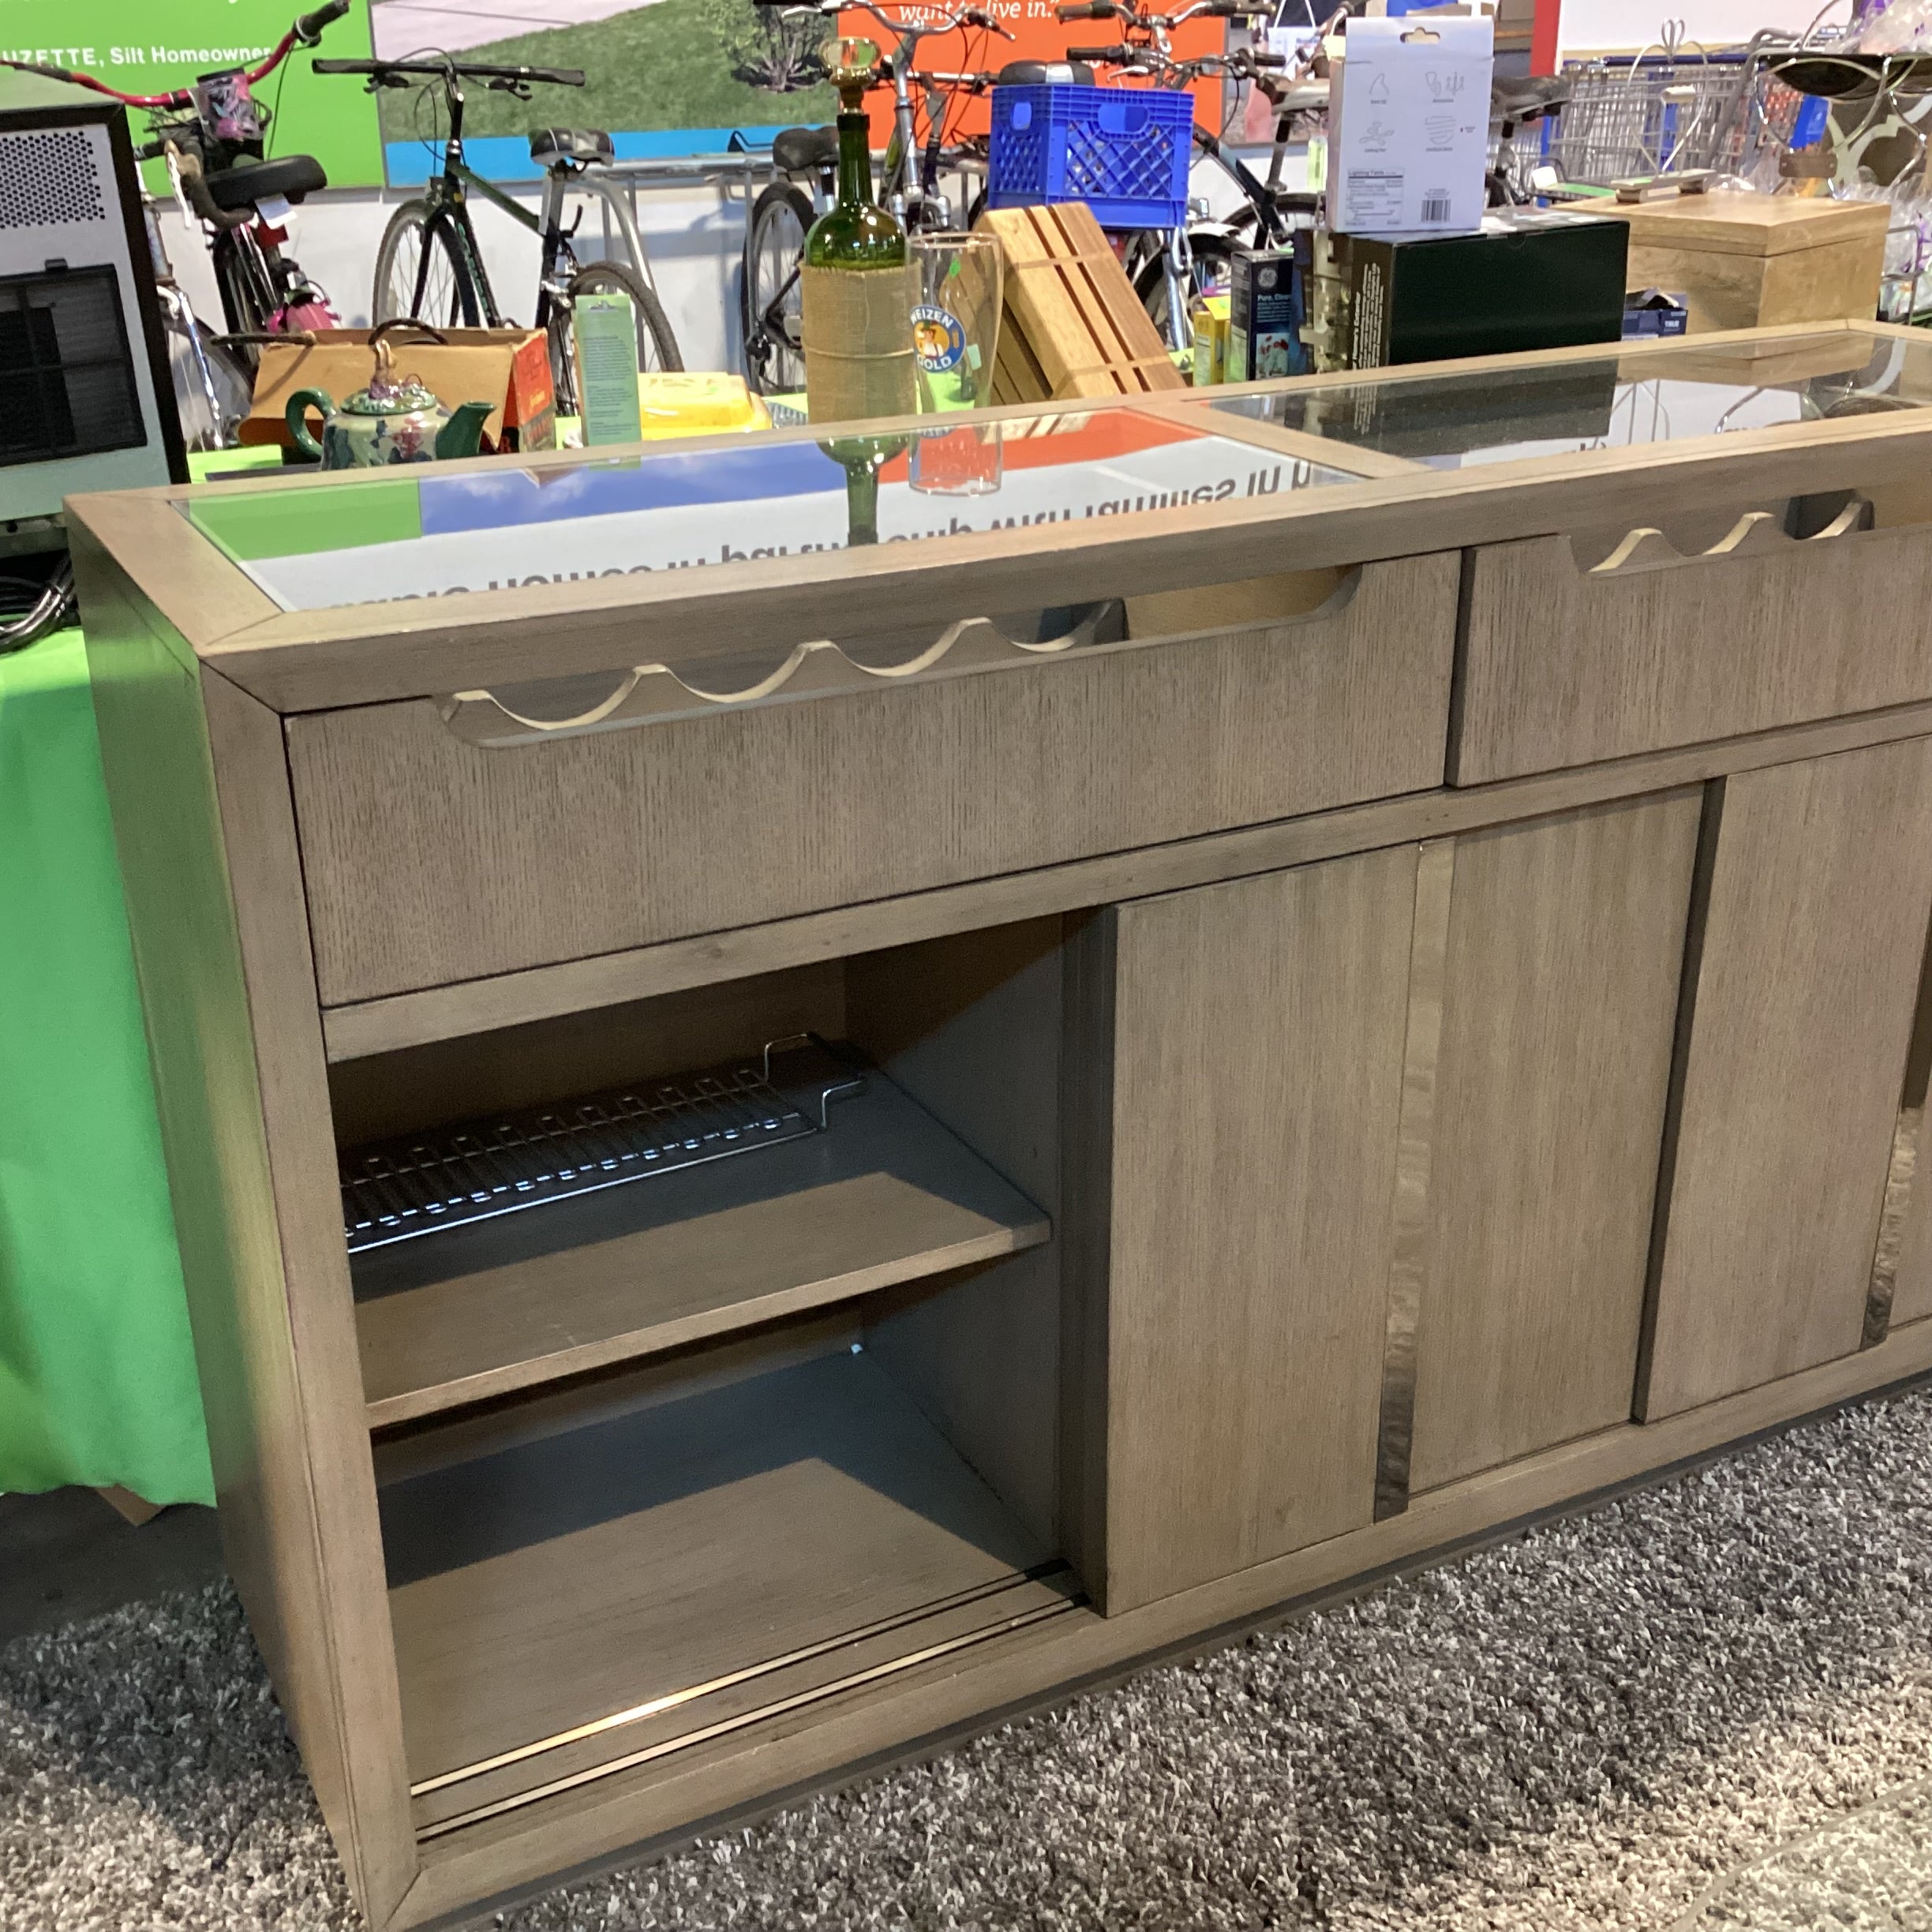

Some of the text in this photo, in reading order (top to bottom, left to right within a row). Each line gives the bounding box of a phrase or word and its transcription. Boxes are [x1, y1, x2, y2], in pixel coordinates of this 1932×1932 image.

[110, 46, 146, 66] Silt
[151, 45, 273, 63] Homeowner
[917, 354, 952, 370] GOLD
